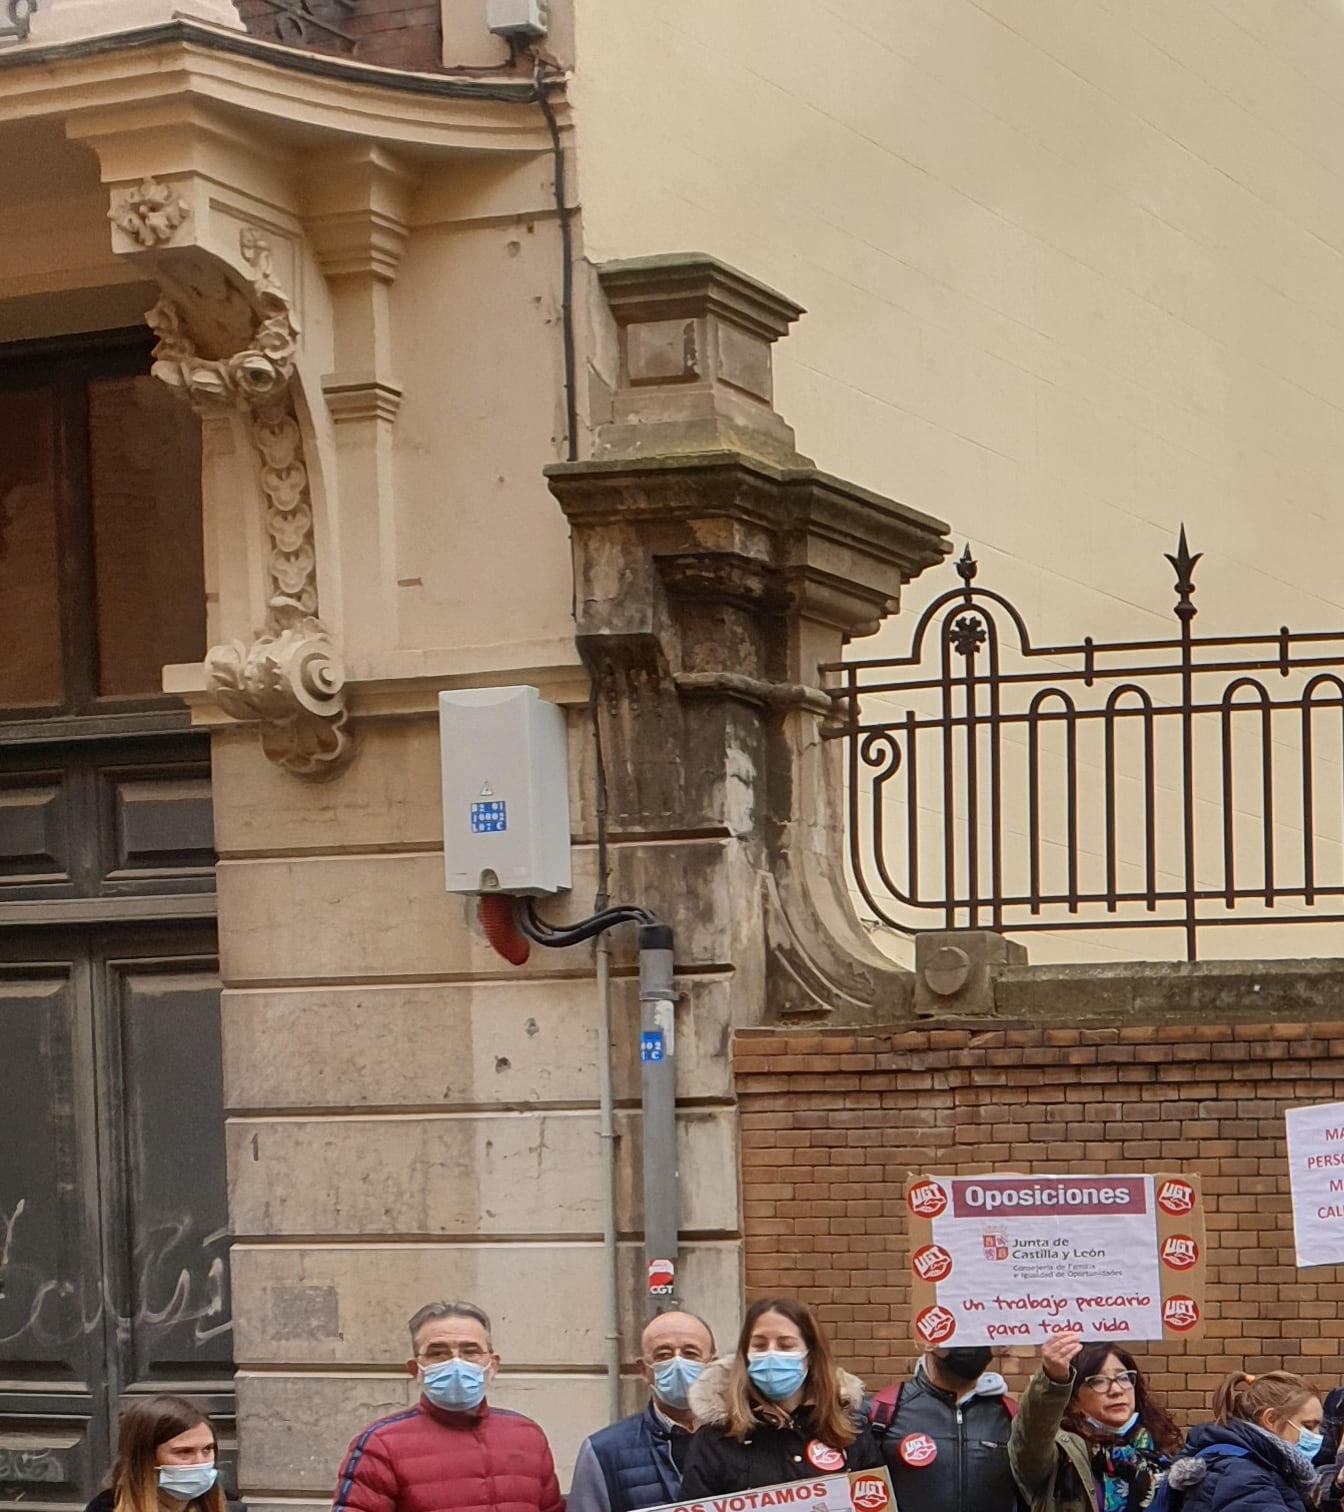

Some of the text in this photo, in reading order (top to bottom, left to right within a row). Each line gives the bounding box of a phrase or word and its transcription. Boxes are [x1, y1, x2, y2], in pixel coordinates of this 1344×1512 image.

[965, 1184, 1130, 1211] Oposiciones
[1012, 1238, 1069, 1248] Junta de
[1012, 1248, 1106, 1260] Castilla y León
[993, 1293, 1067, 1316] trabajo
[1076, 1292, 1151, 1312] precario
[986, 1317, 1130, 1340] para toda vida
